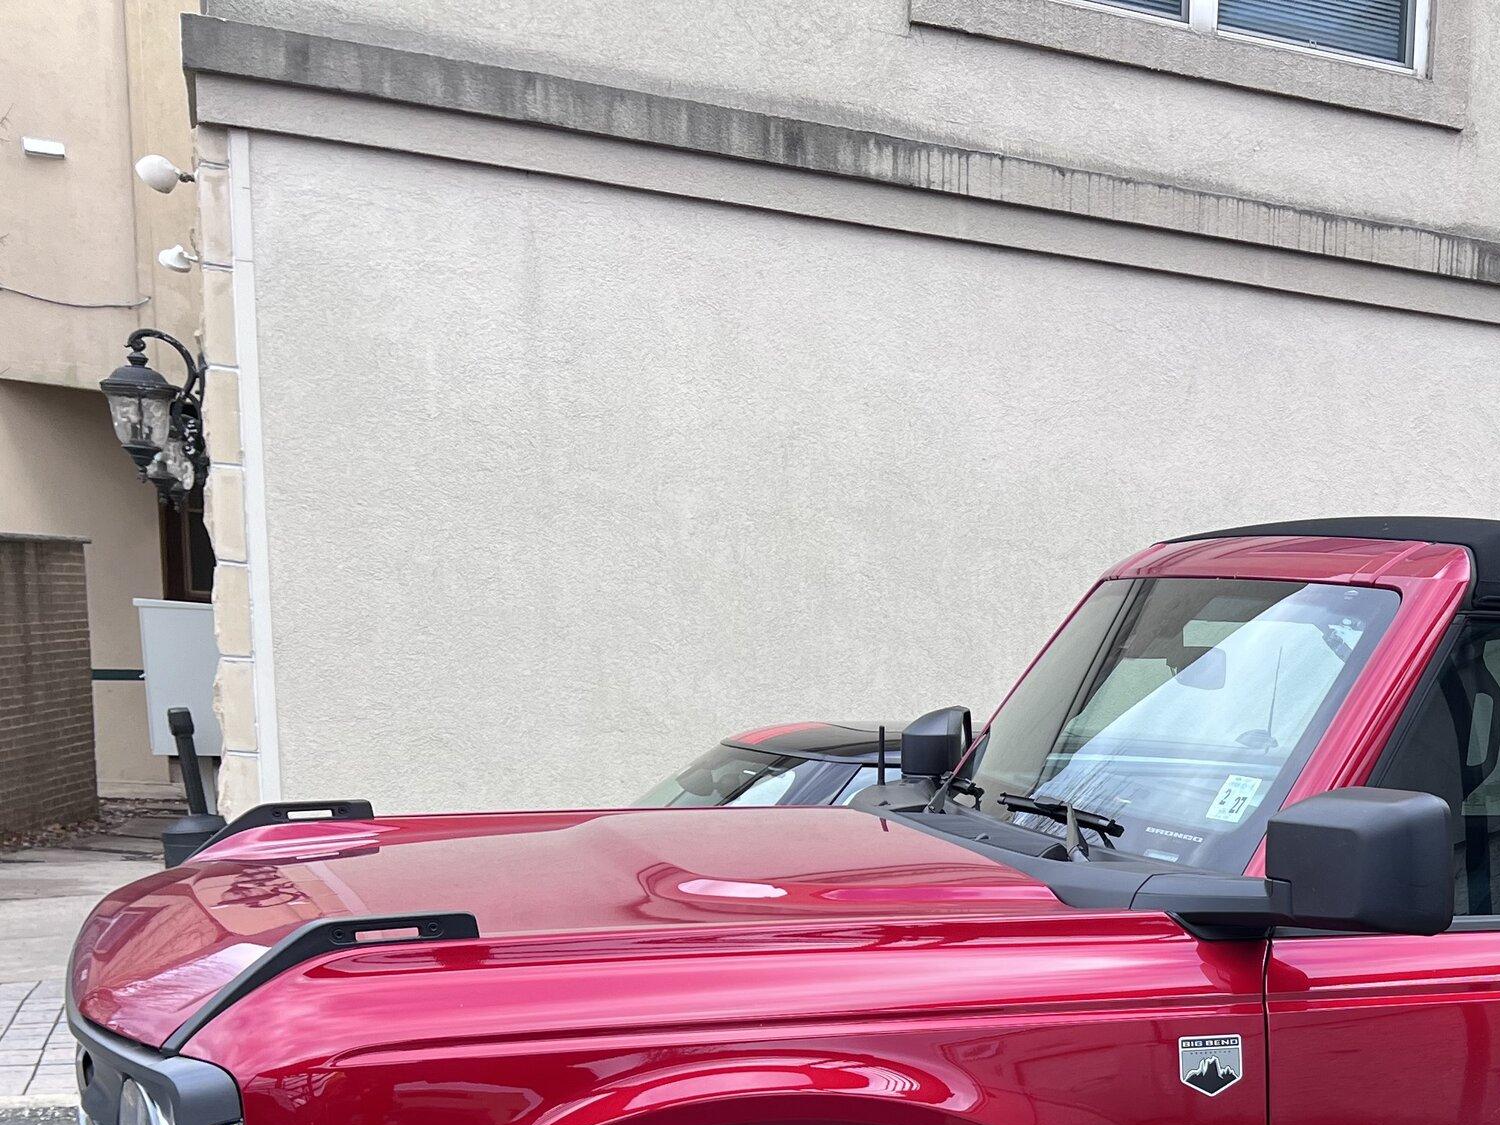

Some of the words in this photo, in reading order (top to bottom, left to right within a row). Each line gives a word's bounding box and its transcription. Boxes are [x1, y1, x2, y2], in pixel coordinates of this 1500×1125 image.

[1228, 796, 1248, 814] 27
[1145, 827, 1203, 843] BRONCO
[1182, 1040, 1203, 1048] BIG
[1205, 1039, 1238, 1047] BEND
